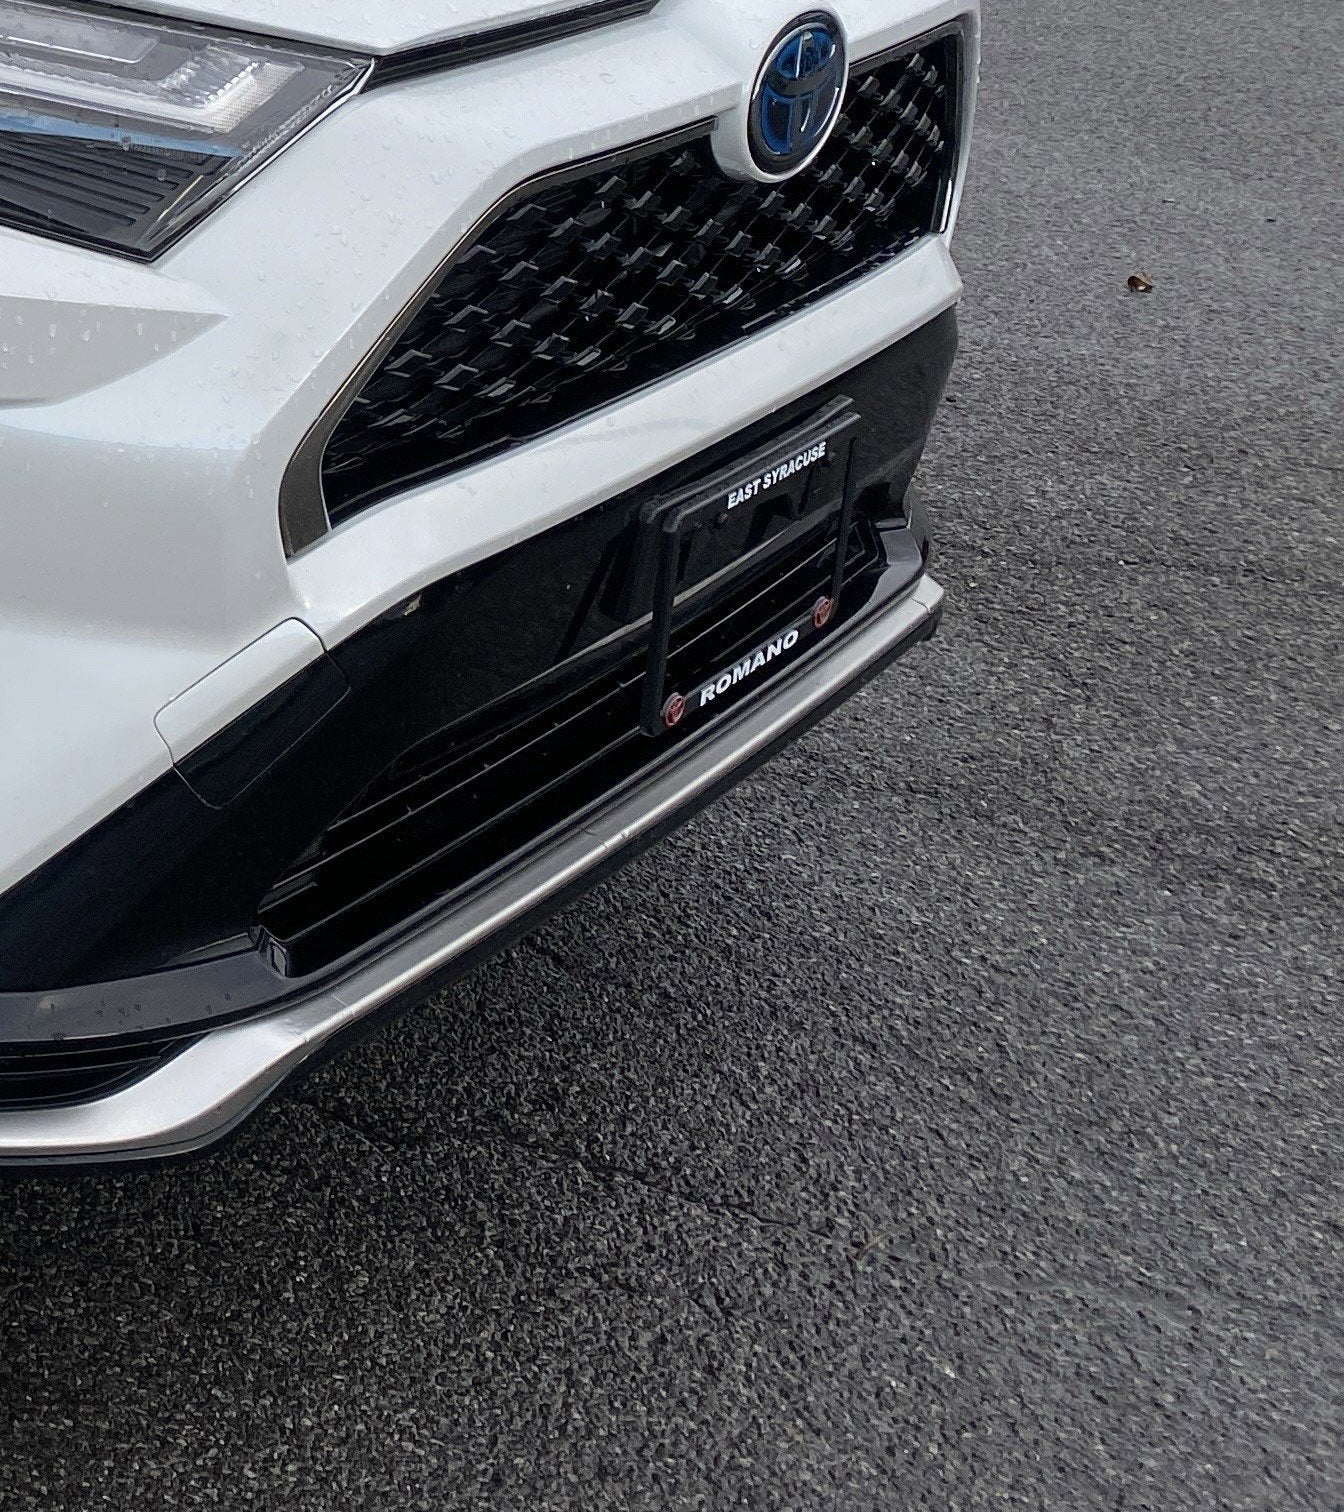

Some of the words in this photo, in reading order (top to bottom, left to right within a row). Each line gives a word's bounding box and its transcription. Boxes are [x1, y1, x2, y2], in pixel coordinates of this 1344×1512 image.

[727, 479, 761, 509] EAST
[762, 441, 827, 491] SYRACUSE
[699, 629, 800, 707] ROMANO
